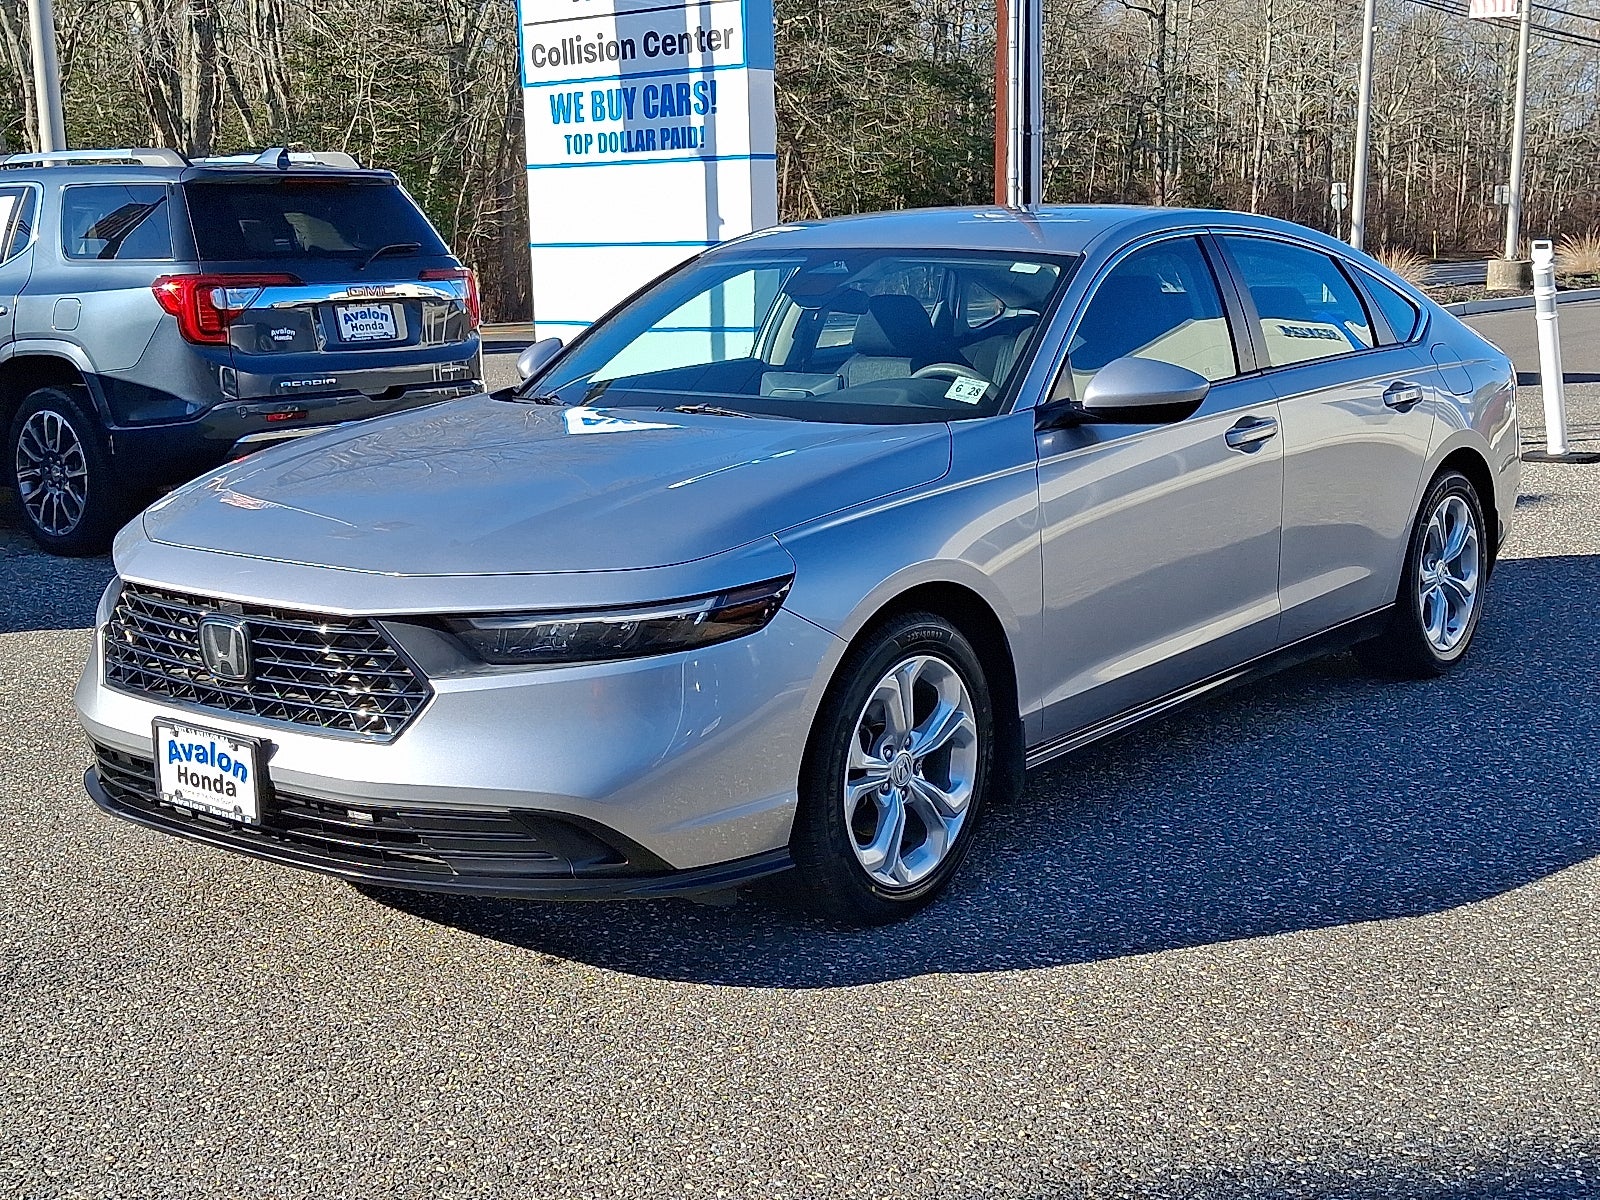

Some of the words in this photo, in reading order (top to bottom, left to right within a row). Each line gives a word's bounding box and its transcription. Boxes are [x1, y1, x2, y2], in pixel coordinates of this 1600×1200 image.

[531, 32, 637, 69] Collision
[643, 26, 734, 58] Center
[550, 92, 585, 124] WE
[591, 87, 637, 122] BUY
[642, 79, 717, 120] CARS!
[564, 133, 593, 155] TOP
[597, 128, 656, 153] DOLLAR
[660, 125, 705, 150] PAID!
[346, 285, 397, 297] GMC
[342, 307, 389, 325] Avalon
[270, 327, 296, 337] Avalon
[350, 320, 385, 332] Honda
[279, 378, 337, 388] ACADIA
[955, 384, 964, 393] 6
[967, 386, 982, 397] 28
[168, 739, 249, 784] Avalon
[177, 764, 238, 798] Honda
